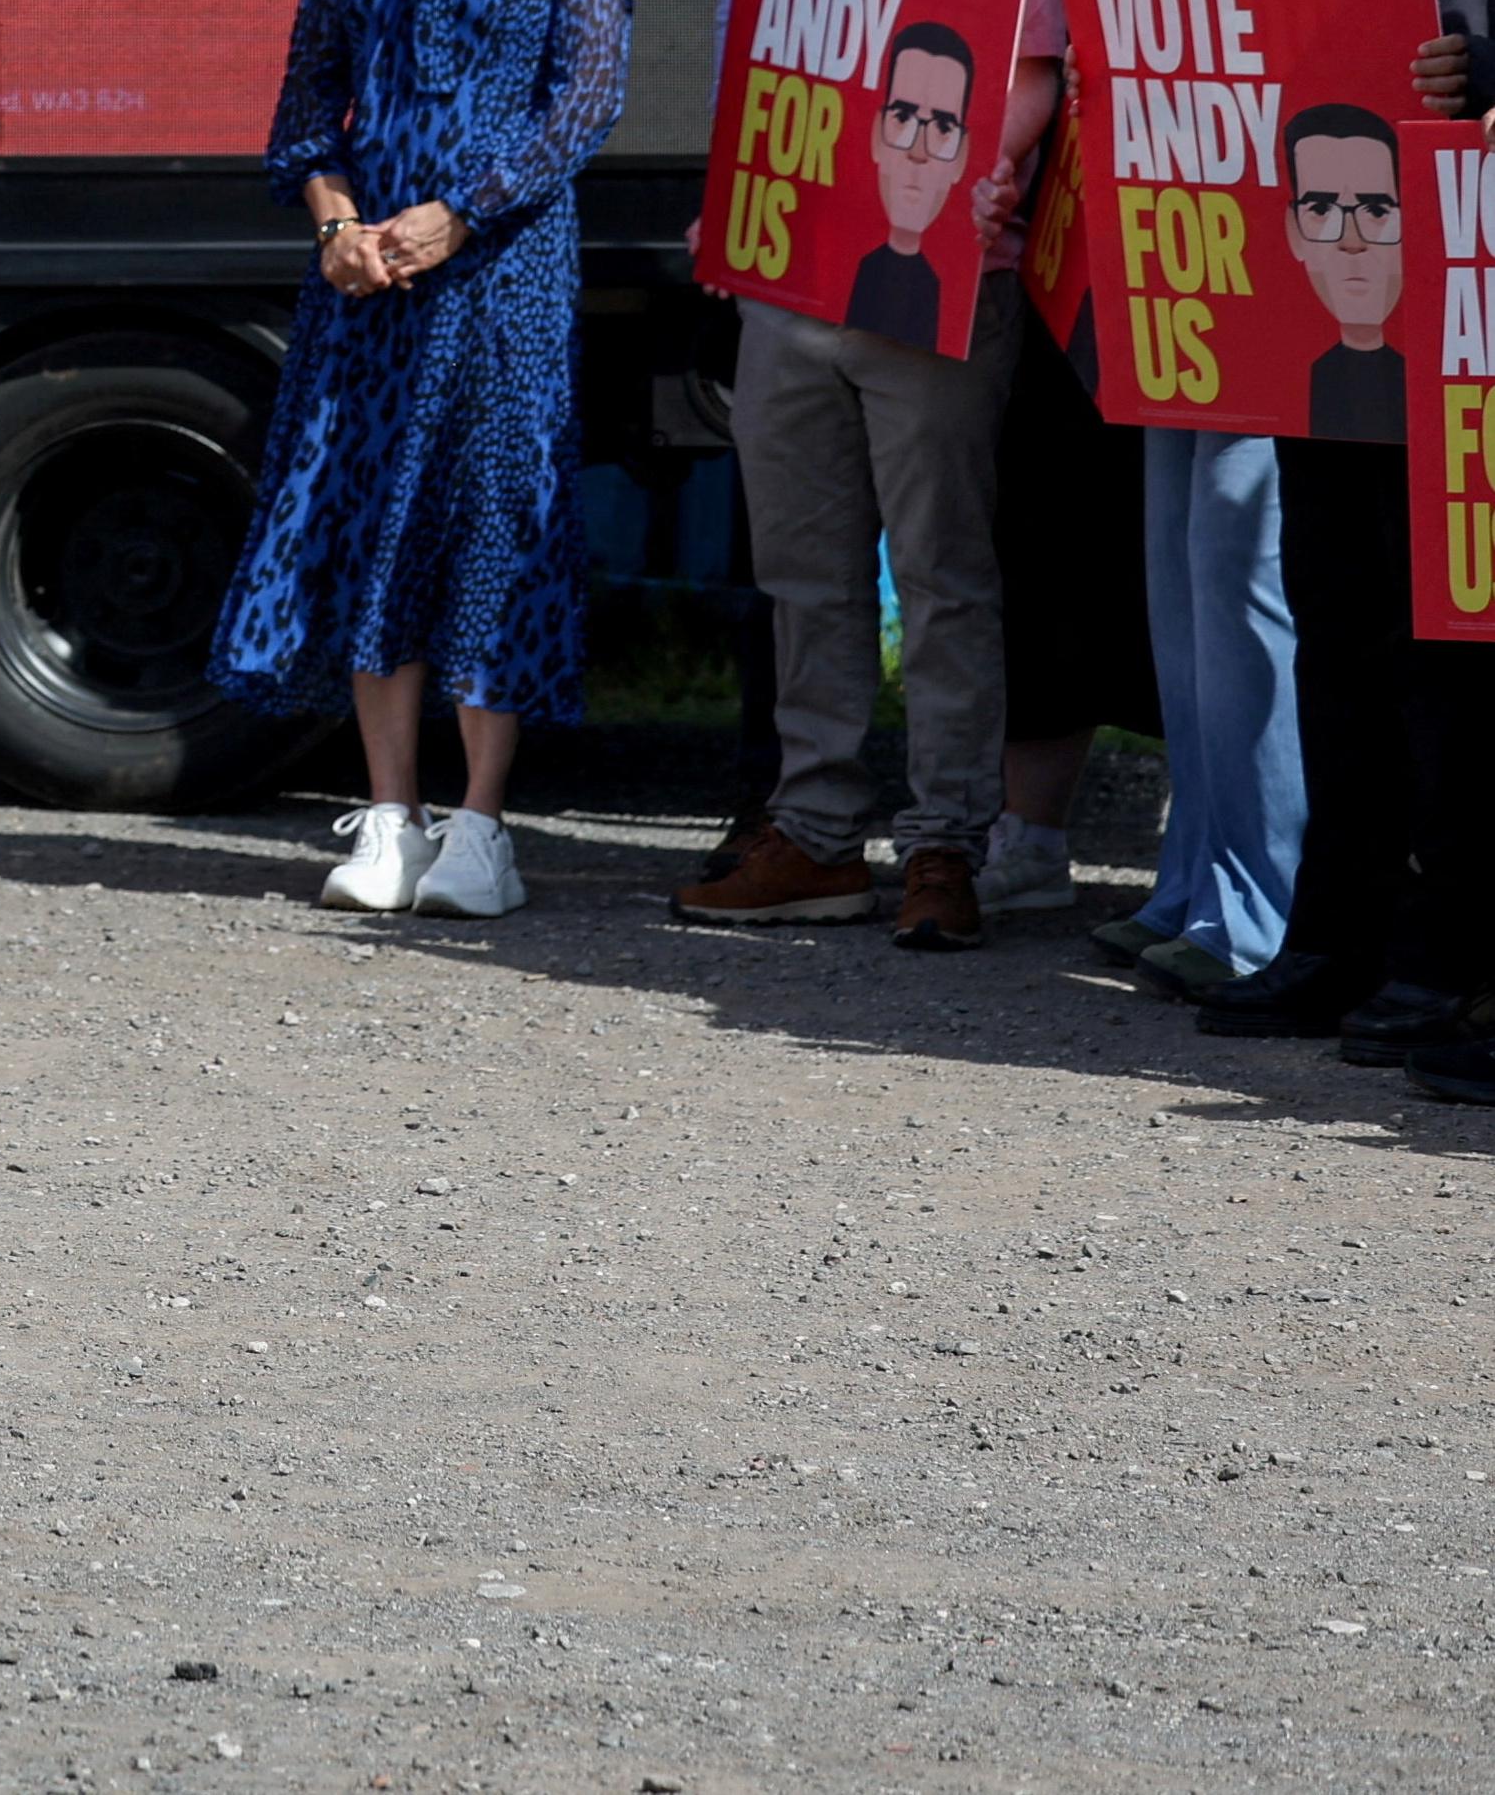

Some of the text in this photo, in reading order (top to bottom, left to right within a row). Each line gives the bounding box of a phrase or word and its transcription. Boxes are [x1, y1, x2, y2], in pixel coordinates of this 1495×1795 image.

[737, 68, 843, 187] FOR
[1111, 77, 1282, 187] ANDY
[725, 173, 798, 280] US
[1117, 187, 1254, 297] FOR
[1128, 297, 1220, 405] US
[1447, 503, 1495, 612] U
